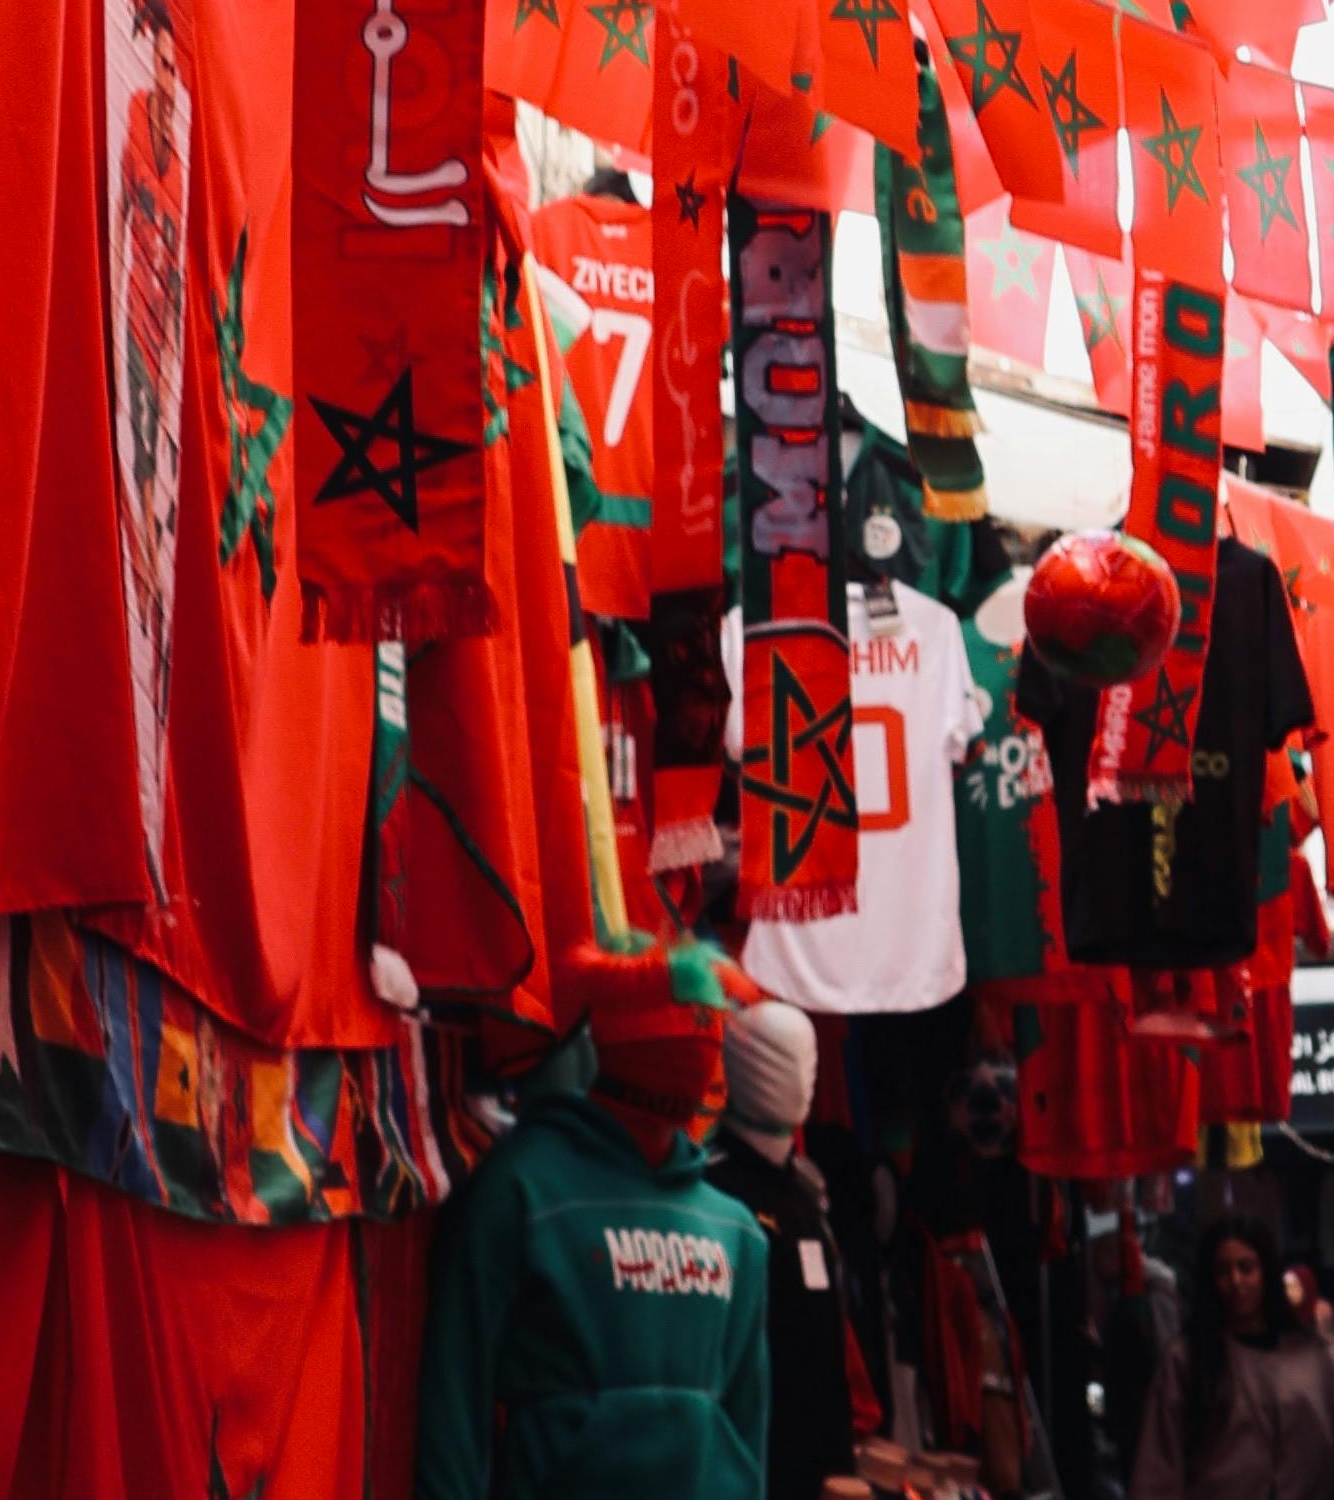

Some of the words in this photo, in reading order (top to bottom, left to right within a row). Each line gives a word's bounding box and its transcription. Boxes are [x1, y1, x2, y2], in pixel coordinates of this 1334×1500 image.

[591, 307, 653, 447] 7
[739, 209, 830, 560] MOR
[1155, 283, 1222, 656] MORO
[851, 638, 921, 677] HIM
